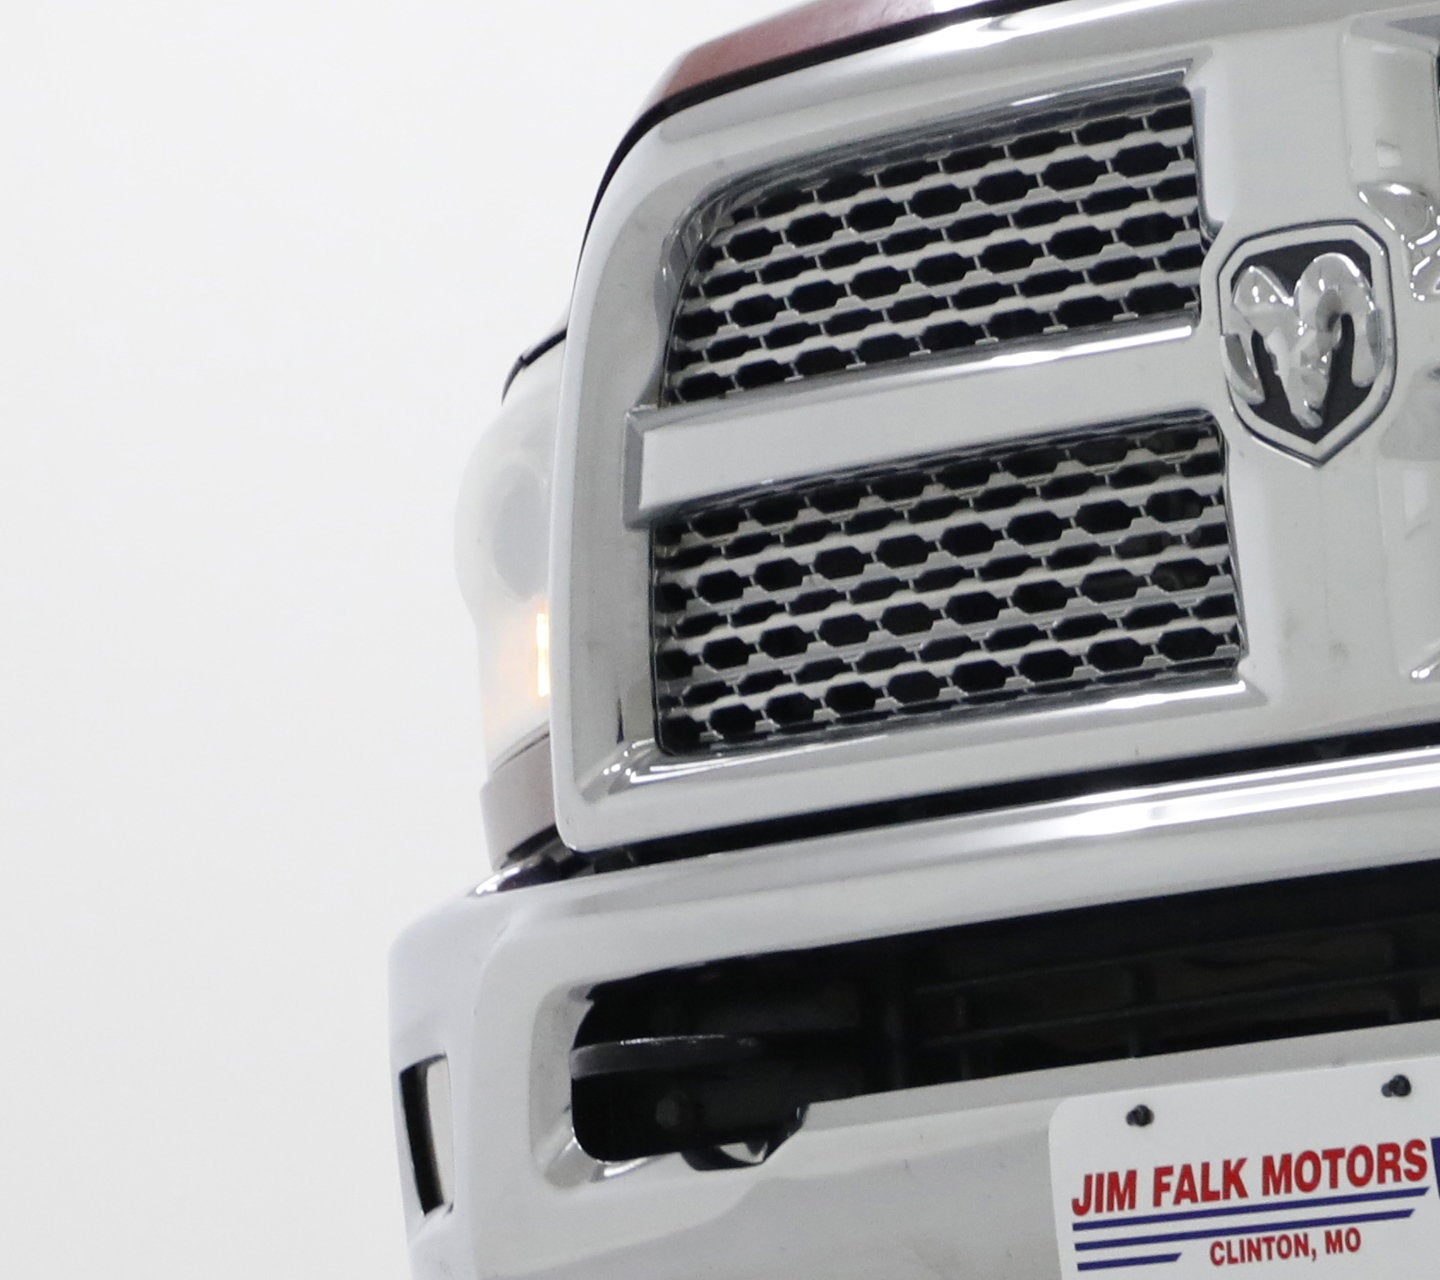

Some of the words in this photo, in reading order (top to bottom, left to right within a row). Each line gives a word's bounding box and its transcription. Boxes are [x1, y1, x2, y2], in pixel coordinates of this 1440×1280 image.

[1072, 1169, 1138, 1216] JIM
[1153, 1157, 1248, 1207] FALK
[1262, 1138, 1429, 1196] MOTORS
[1211, 1232, 1318, 1266] CLINTON,
[1325, 1227, 1362, 1253] MO
